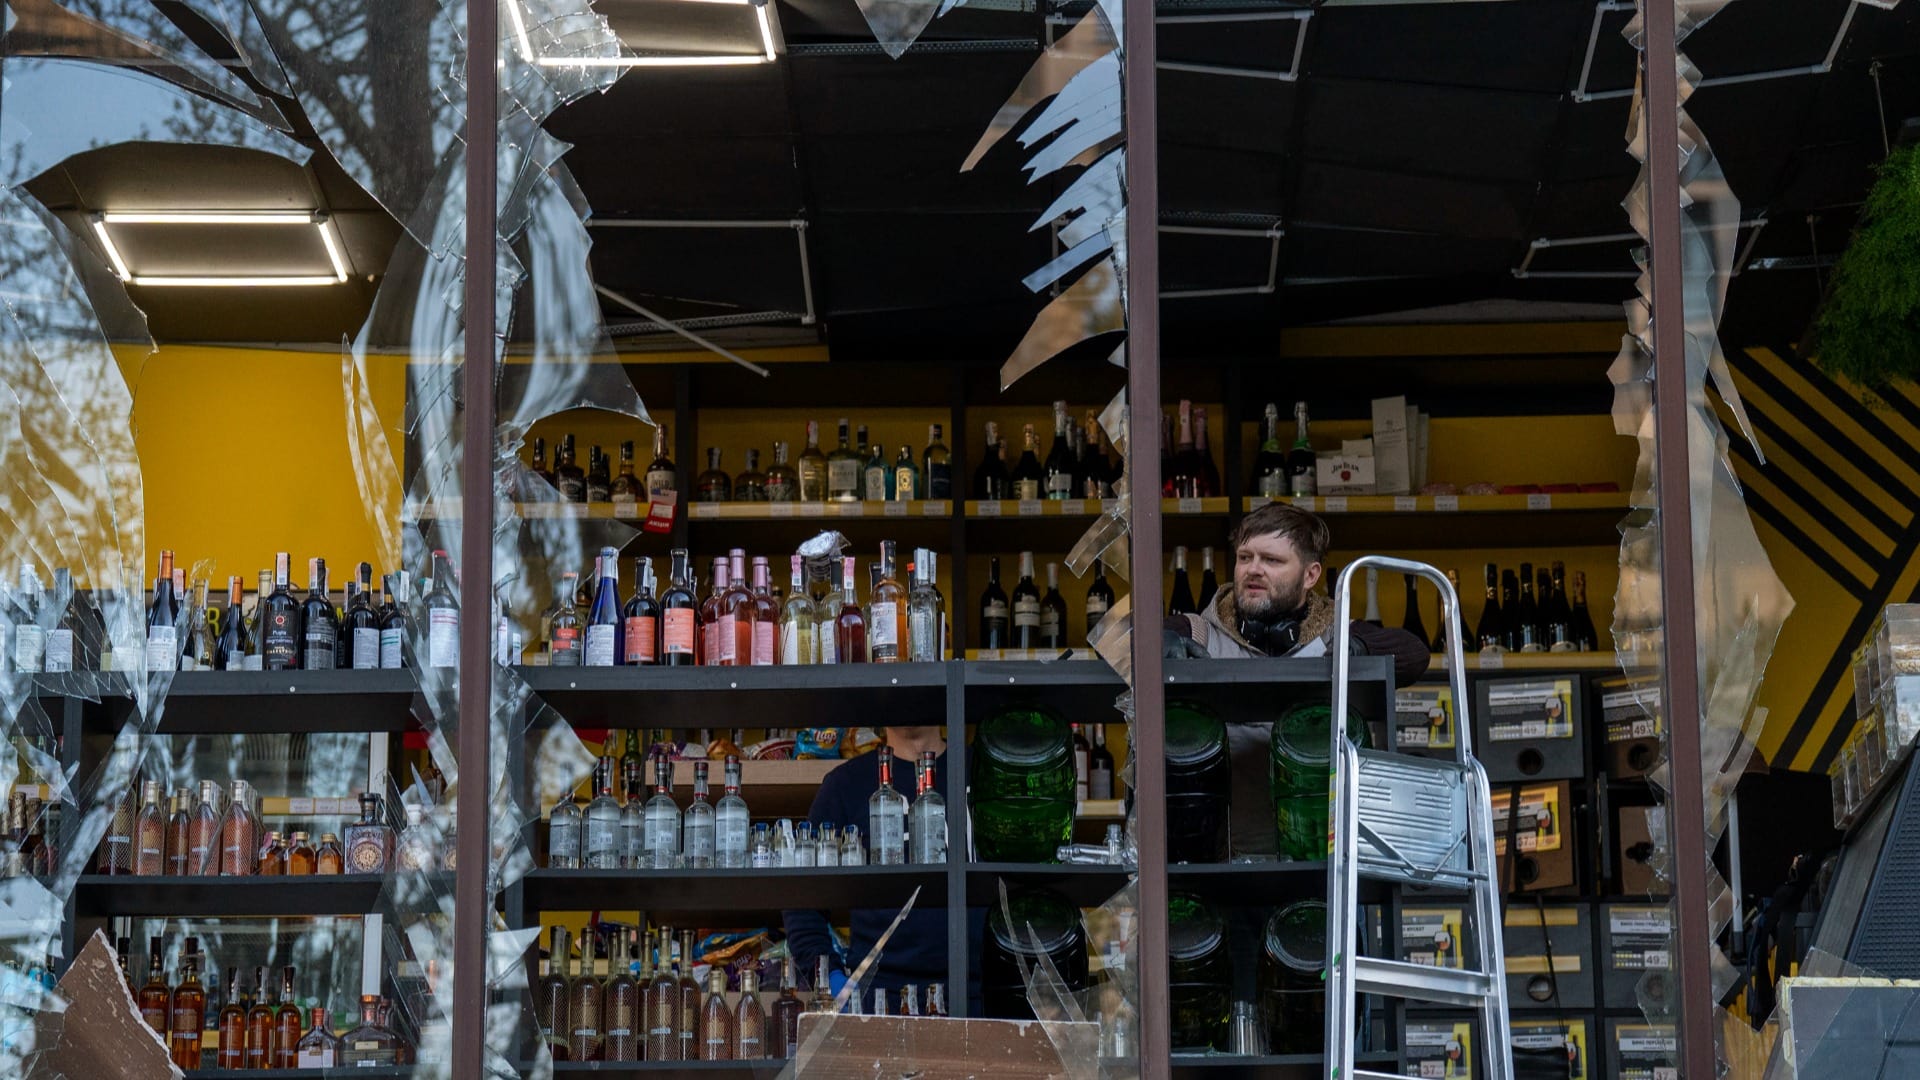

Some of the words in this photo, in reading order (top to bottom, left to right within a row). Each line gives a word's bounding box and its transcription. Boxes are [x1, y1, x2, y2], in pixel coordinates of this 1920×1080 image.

[1634, 724, 1646, 735] 49
[1406, 731, 1418, 741] 37
[1646, 955, 1660, 965] 49
[1423, 1064, 1436, 1075] 37
